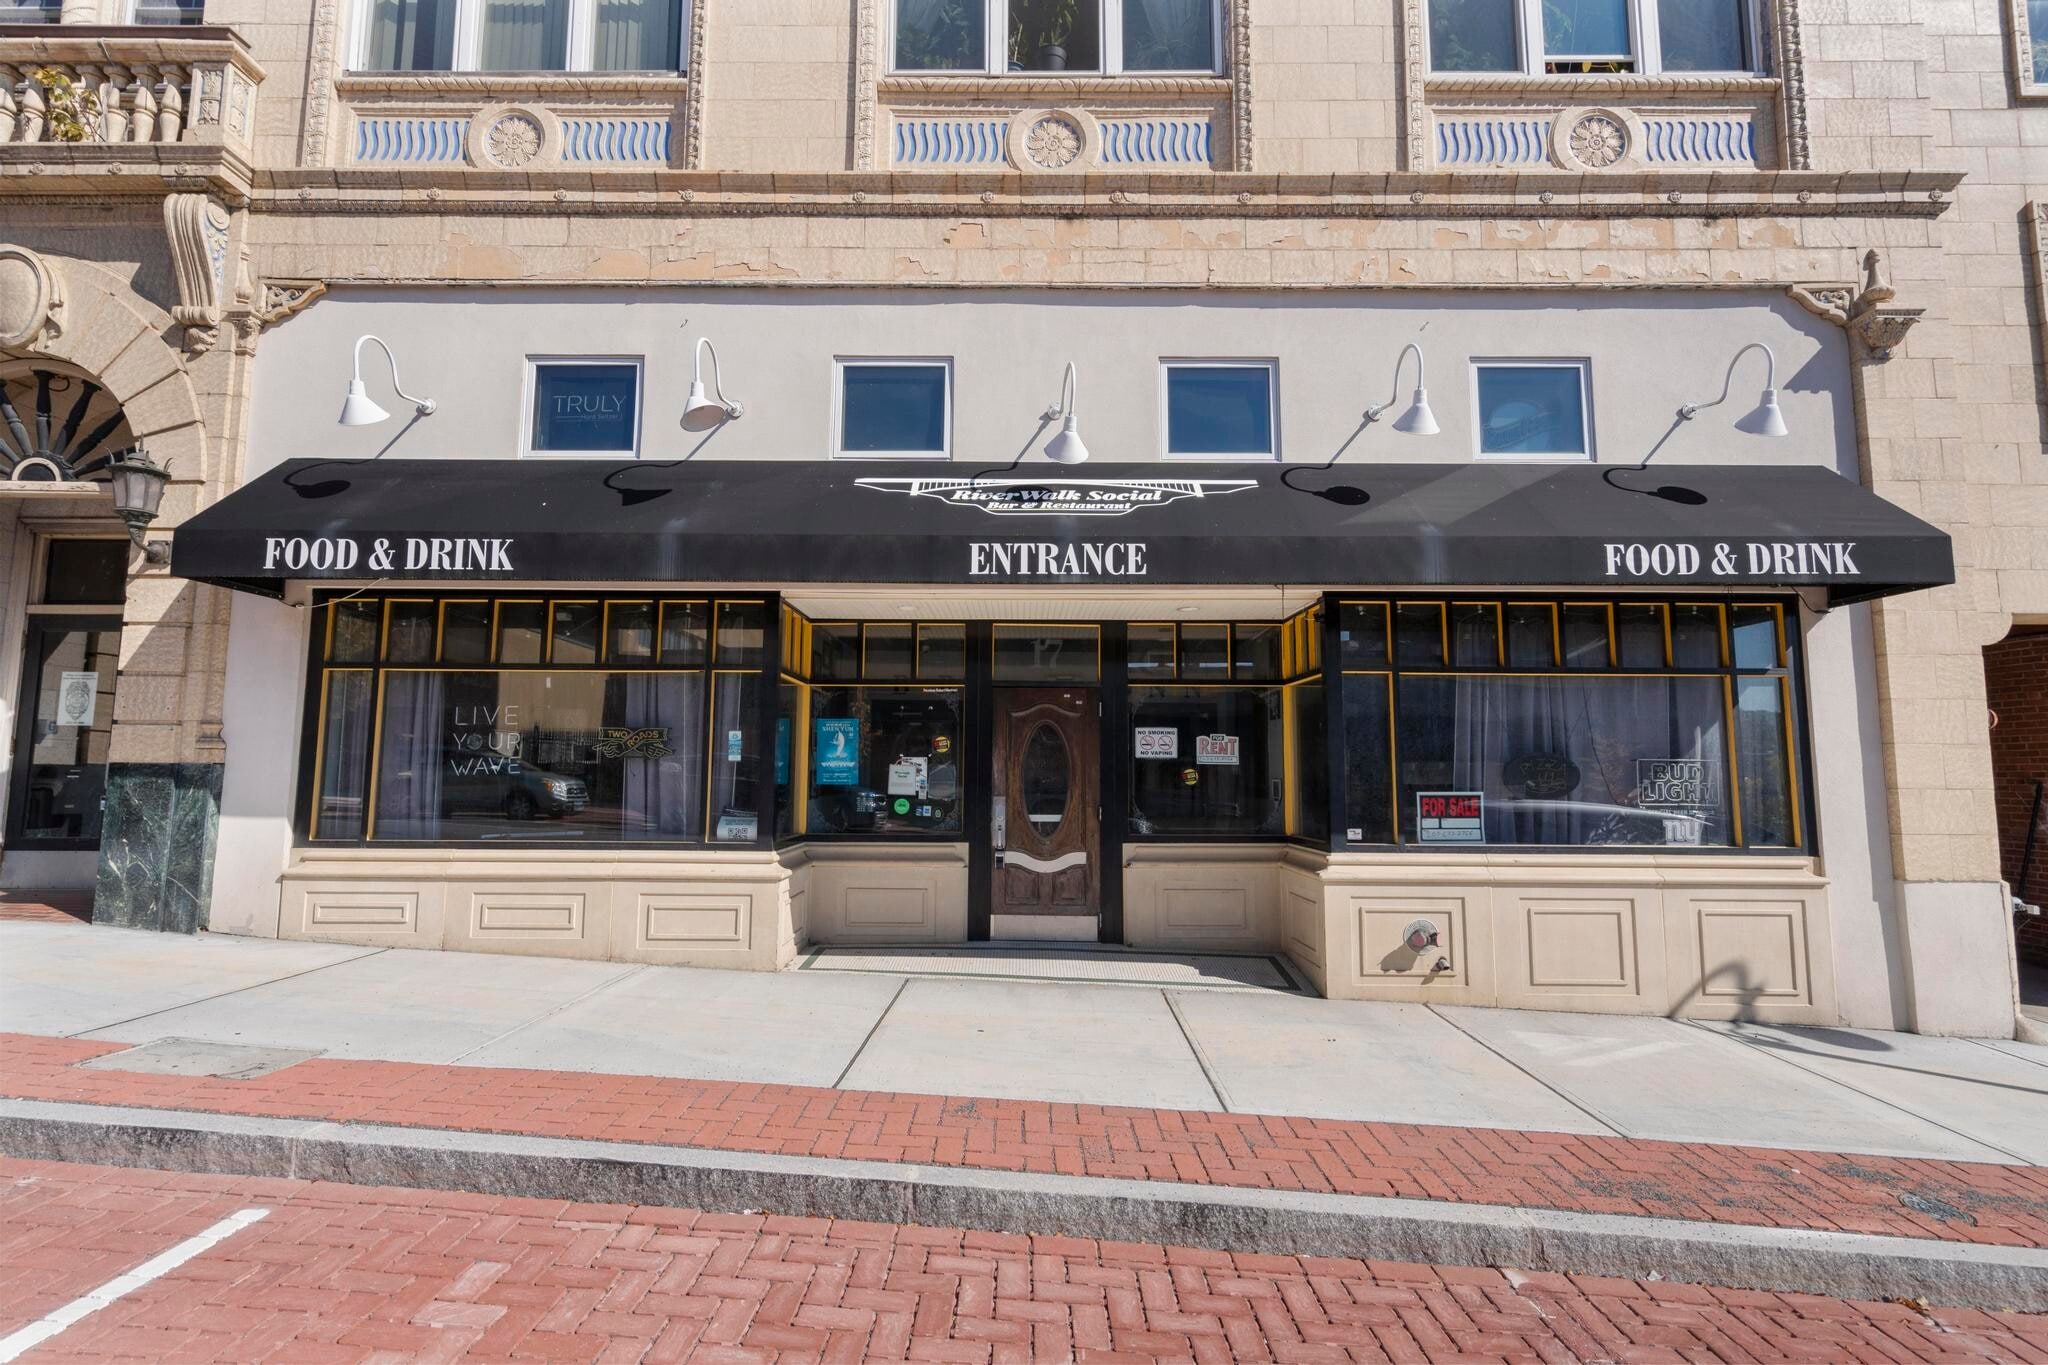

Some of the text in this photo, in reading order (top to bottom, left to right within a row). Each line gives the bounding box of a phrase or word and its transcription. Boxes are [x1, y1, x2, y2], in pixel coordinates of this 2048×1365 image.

[552, 395, 627, 412] TRULY
[950, 490, 1162, 502] RiverWalk Social
[986, 501, 1132, 510] Bar & Restaurant
[263, 537, 514, 571] FOOD & DRINK
[969, 542, 1147, 576] ENTRANCE
[1604, 542, 1861, 576] FOOD & DRINK
[1031, 638, 1064, 669] 17
[455, 705, 520, 726] LIVE
[452, 732, 521, 751] YOUR
[608, 730, 659, 748] TWO ROADS
[1199, 738, 1237, 755] RENT
[450, 757, 521, 776] WAVE
[1650, 763, 1704, 782] BUD
[1640, 781, 1717, 801] LIGHT
[1422, 797, 1480, 817] FOR SALE
